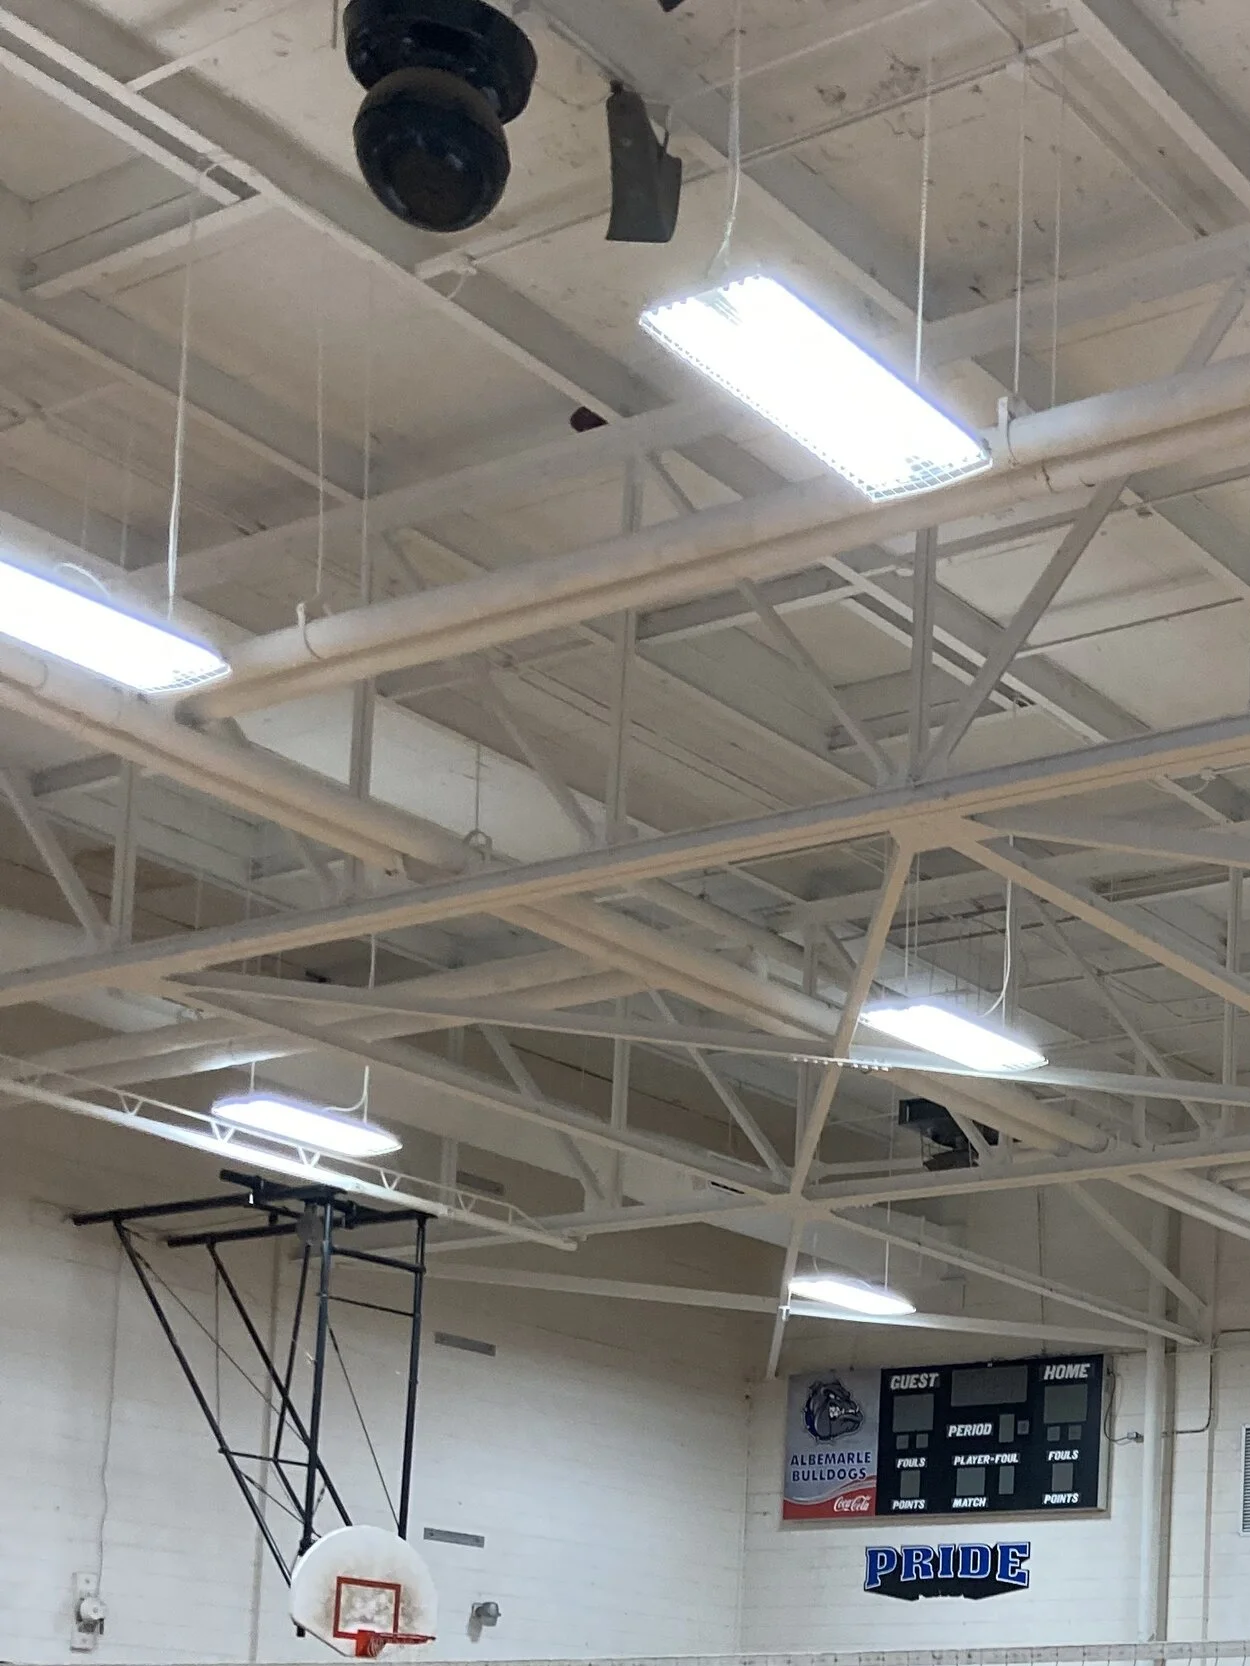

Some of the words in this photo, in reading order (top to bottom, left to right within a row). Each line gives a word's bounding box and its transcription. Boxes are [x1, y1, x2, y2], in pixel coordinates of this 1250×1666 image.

[1043, 1363, 1090, 1380] HOME
[890, 1373, 939, 1390] GUEST
[947, 1423, 992, 1437] PERIOD
[790, 1452, 871, 1466] ALBEMARLE
[1047, 1450, 1079, 1461] FOULS
[896, 1458, 926, 1469] FOULS
[792, 1467, 867, 1482] BULLDOGS
[892, 1500, 926, 1510] POINTS
[952, 1497, 987, 1509] MATCH
[1043, 1493, 1079, 1505] POINTS
[864, 1541, 1031, 1590] PRIDE
